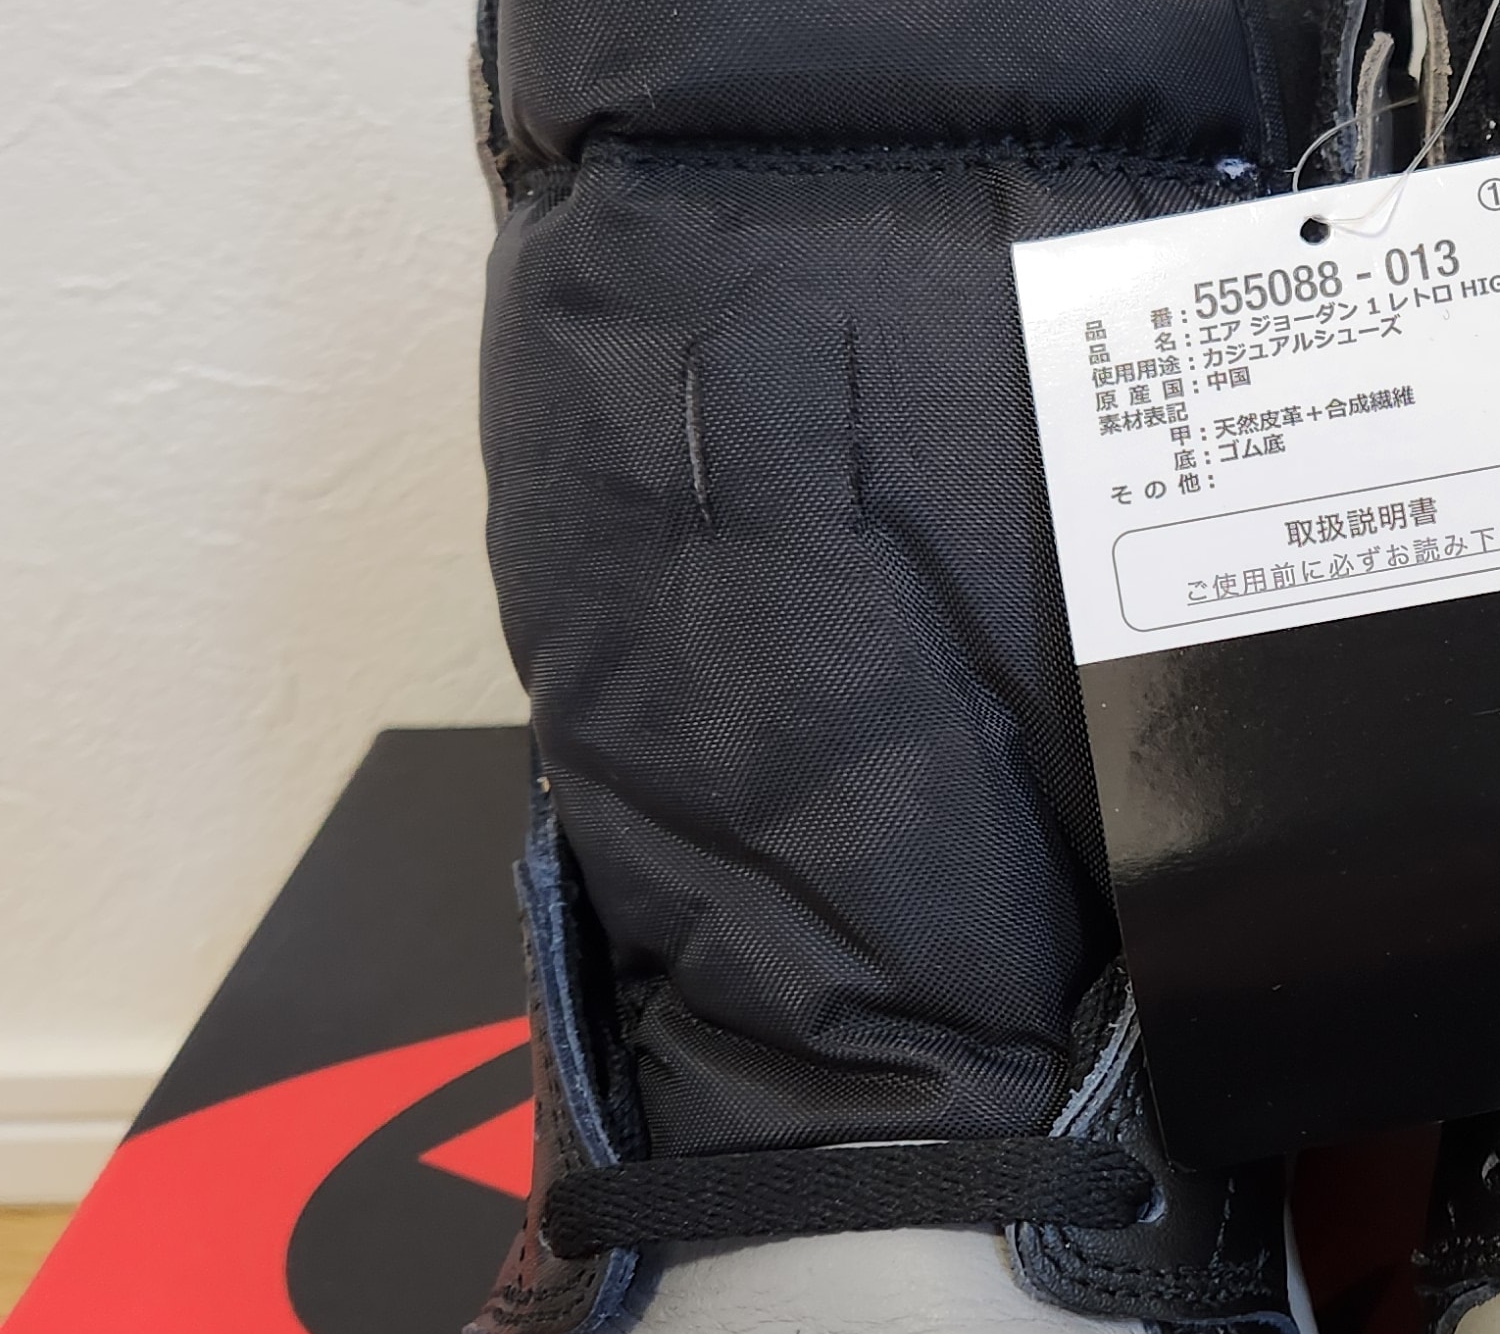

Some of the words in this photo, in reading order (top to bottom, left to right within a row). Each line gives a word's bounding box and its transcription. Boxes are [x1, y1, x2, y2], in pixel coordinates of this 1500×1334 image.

[1098, 402, 1189, 436] 素材表記
[1285, 496, 1439, 548] 取扱説明書
